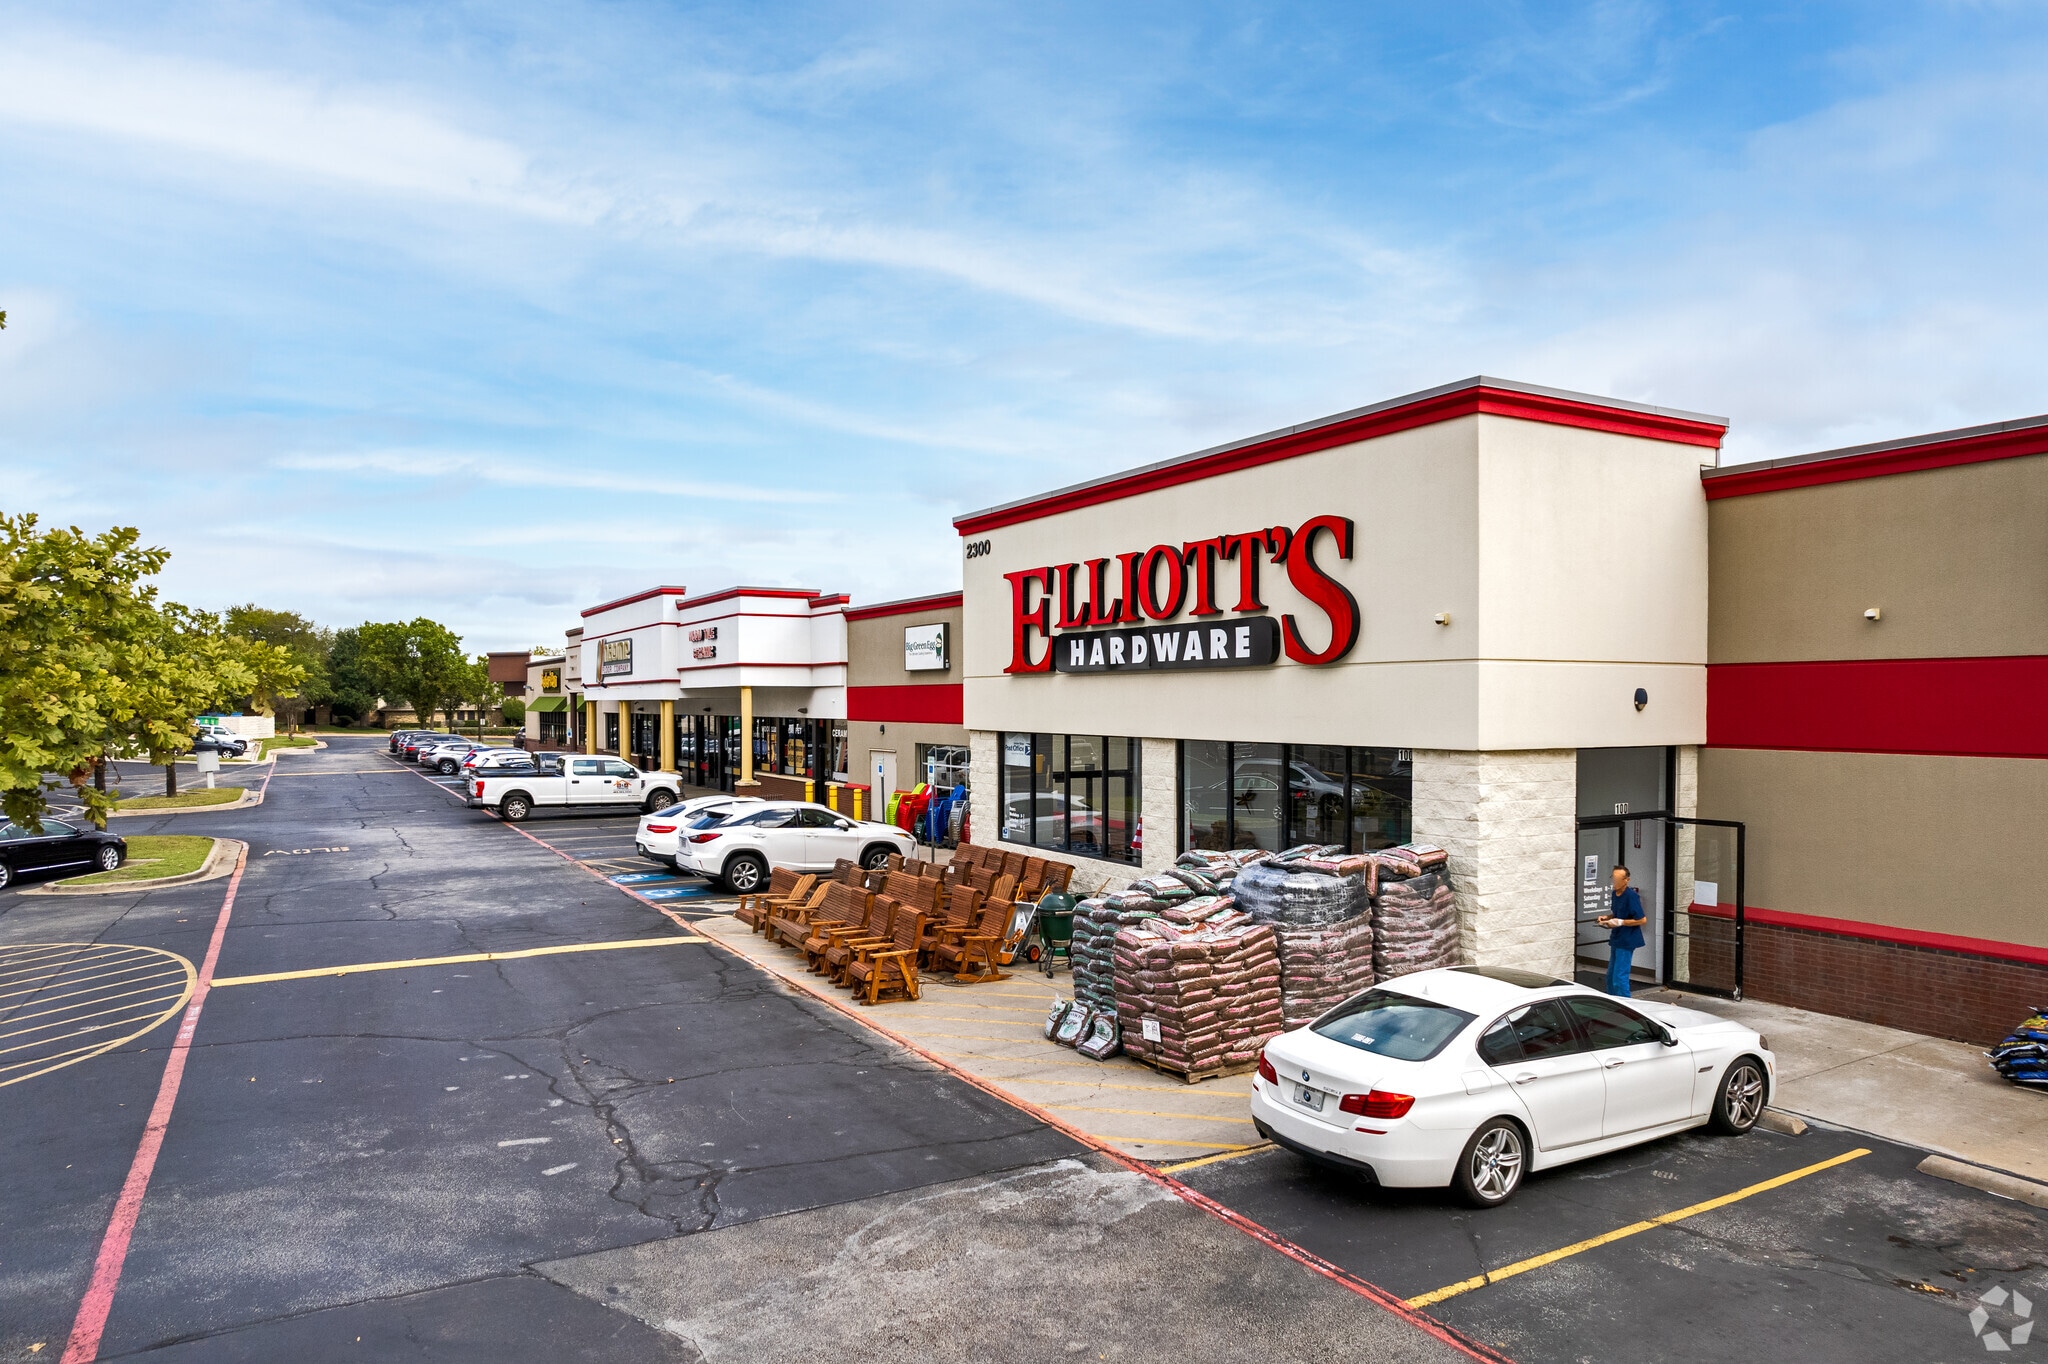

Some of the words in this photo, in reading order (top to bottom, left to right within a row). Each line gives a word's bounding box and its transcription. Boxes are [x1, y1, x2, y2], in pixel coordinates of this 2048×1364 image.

[966, 539, 991, 559] 2300
[1003, 515, 1361, 675] ELLIOTT'S
[913, 641, 927, 651] Green
[927, 640, 935, 651] Egg
[1069, 625, 1251, 667] HARDWARE
[1400, 750, 1412, 761] 100
[1615, 803, 1628, 815] 100
